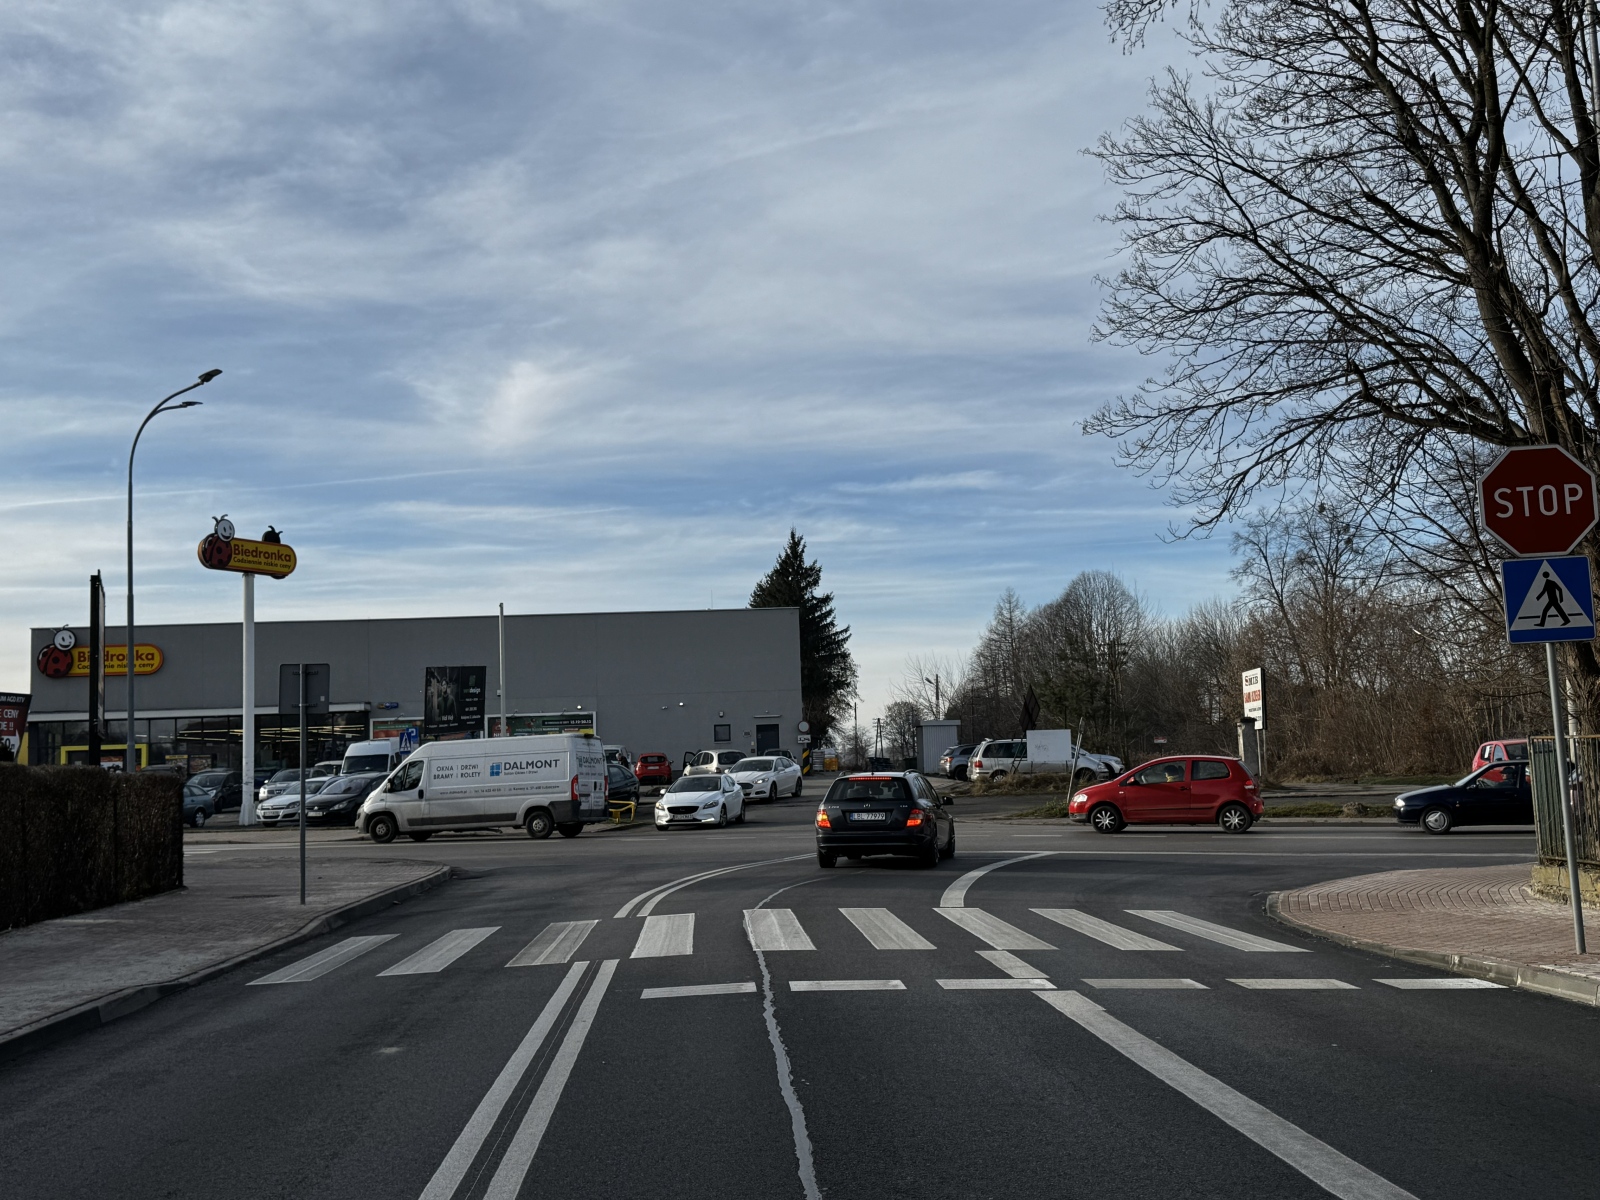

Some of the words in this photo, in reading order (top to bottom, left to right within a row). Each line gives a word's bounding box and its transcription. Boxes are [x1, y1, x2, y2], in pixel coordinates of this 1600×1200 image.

[1493, 482, 1584, 519] STOP
[233, 543, 291, 562] Biedronka
[77, 650, 154, 662] Bidroka
[3, 709, 19, 718] CENY
[504, 759, 560, 770] DALMONT
